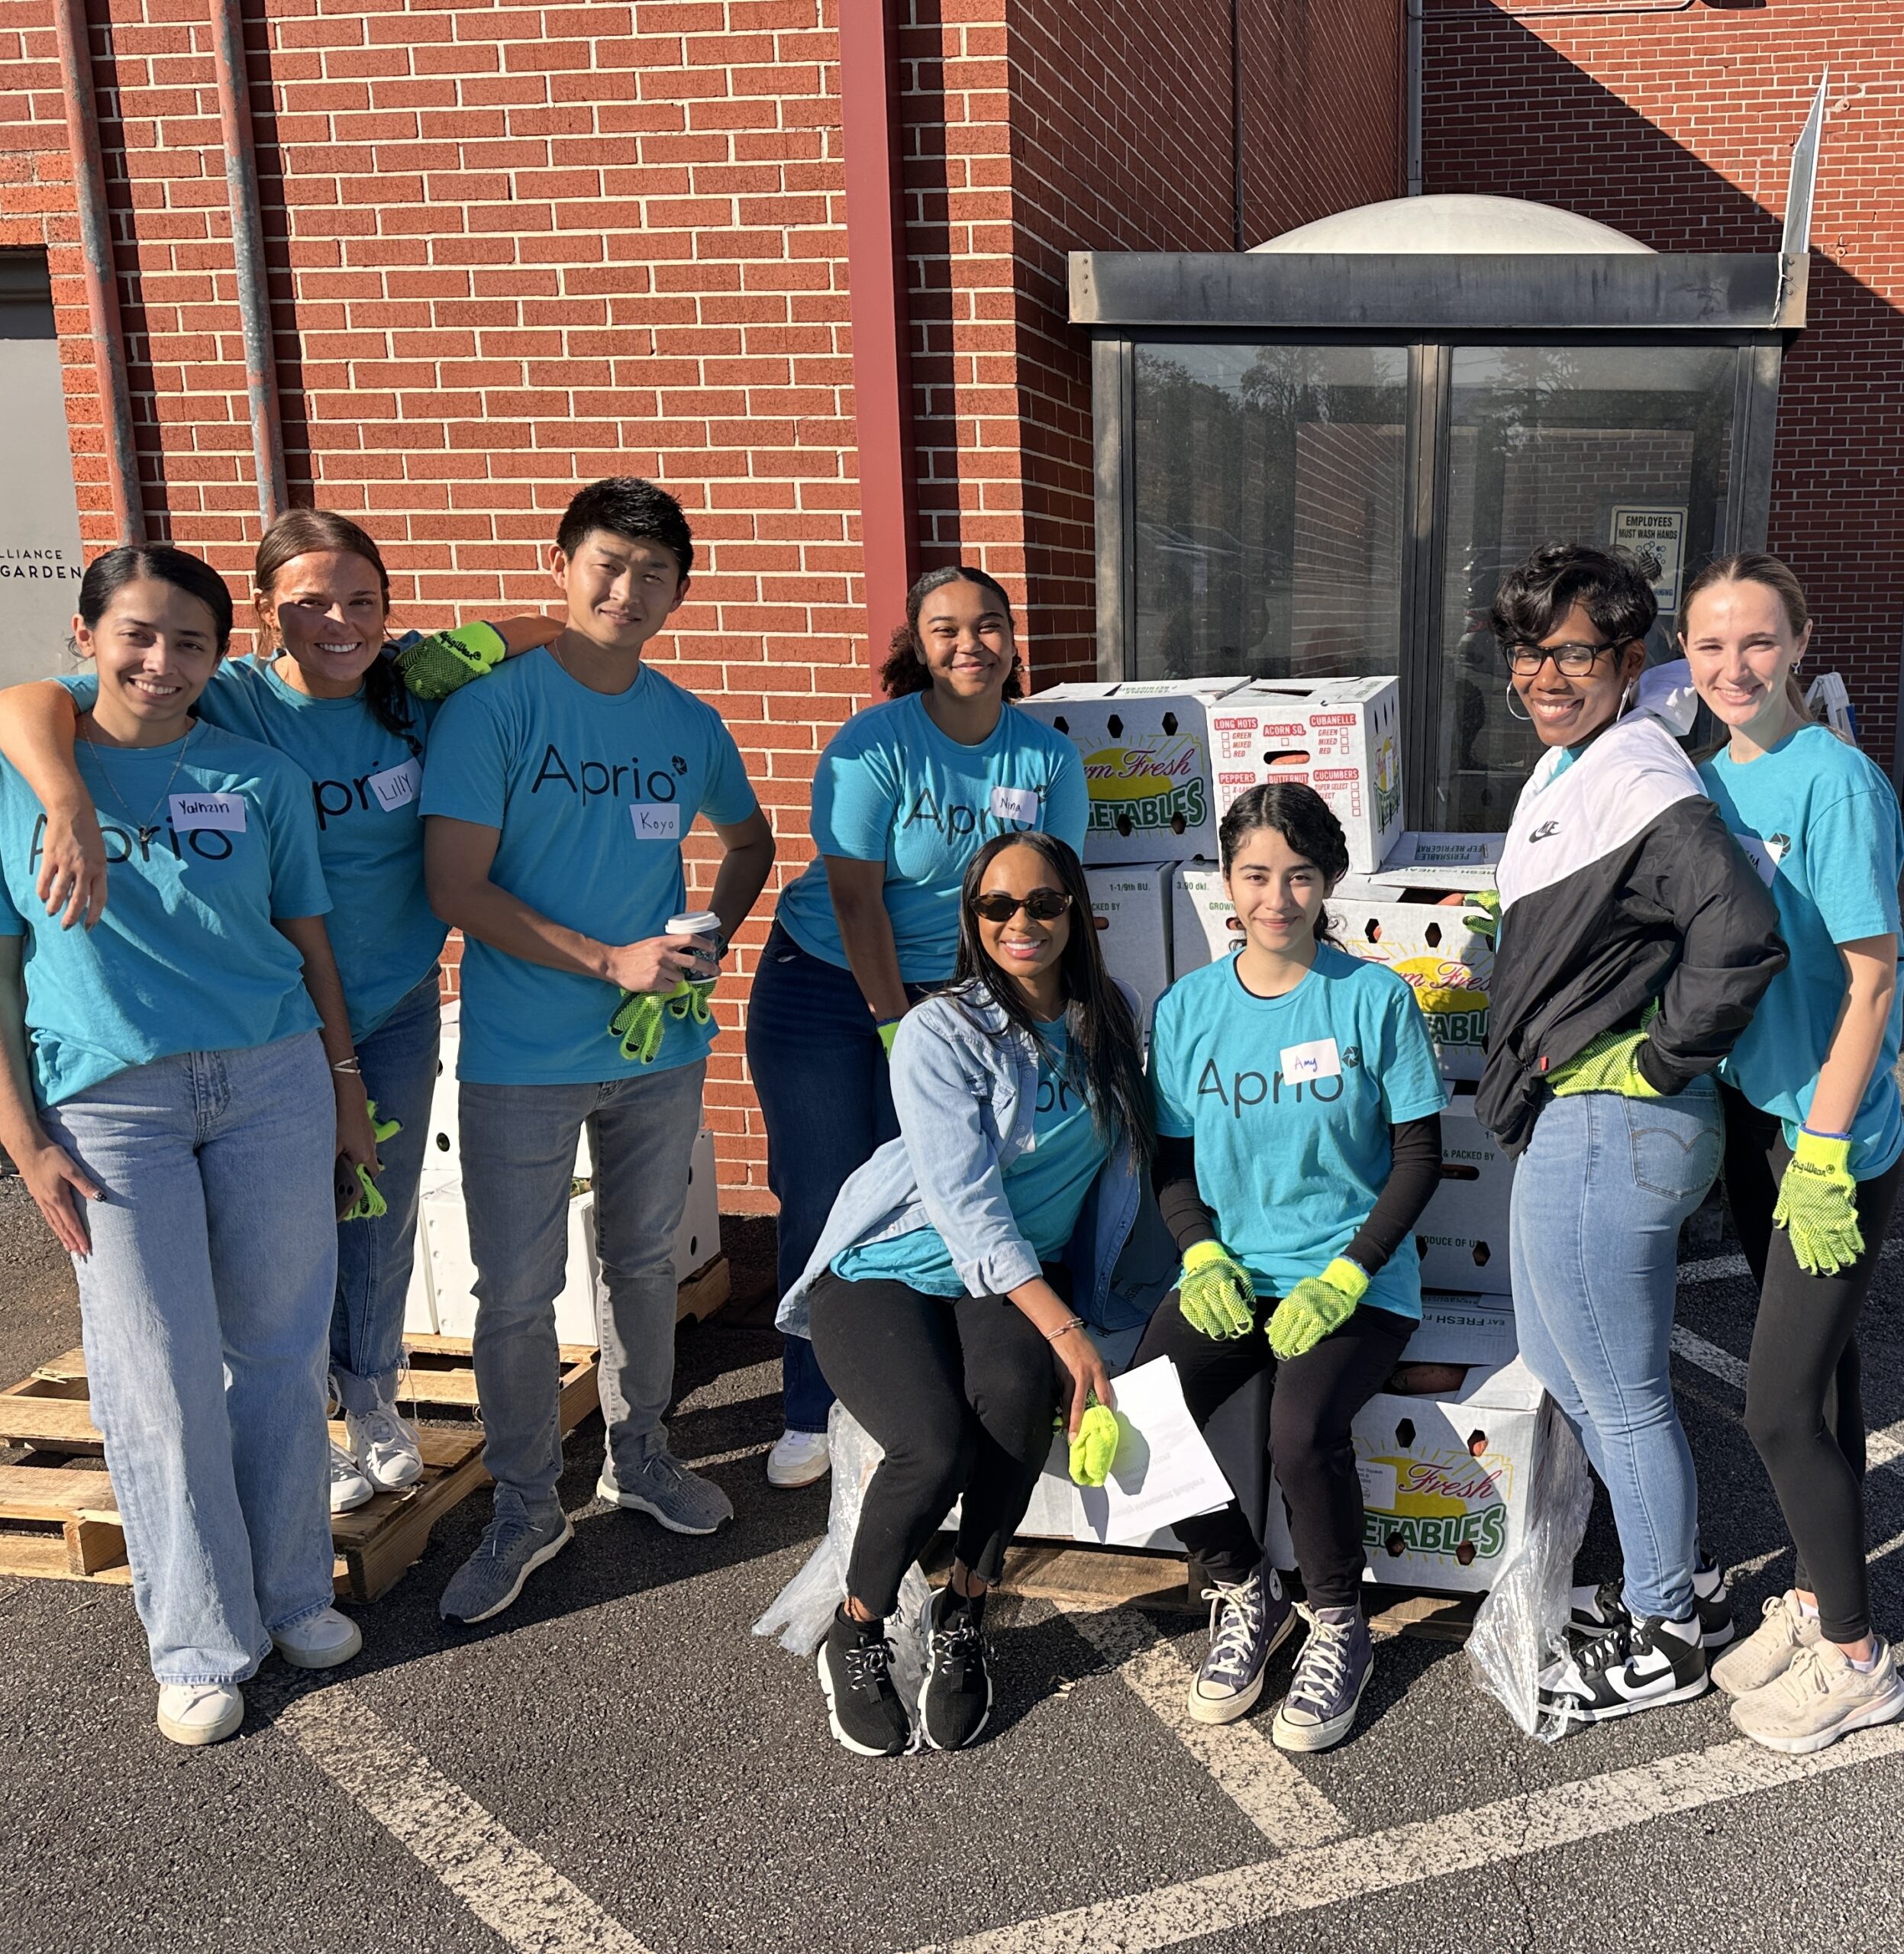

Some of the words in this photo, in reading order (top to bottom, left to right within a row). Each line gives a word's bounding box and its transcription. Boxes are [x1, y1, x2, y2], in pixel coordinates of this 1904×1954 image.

[1625, 515, 1673, 527] EMPLOYEES
[1618, 529, 1636, 539] MUST
[1638, 529, 1655, 540] WASH
[1657, 530, 1678, 540] HANDS
[0, 565, 82, 579] GARDEN
[1215, 718, 1235, 730] LONG
[1237, 717, 1257, 729] HOTS
[1310, 714, 1355, 726] CUBANELLE
[1263, 725, 1290, 735] ACORN
[1292, 724, 1305, 734] SQ.
[1118, 748, 1196, 779] Fresh
[531, 743, 676, 807] Aprio
[1219, 773, 1255, 783] PEPPERS
[1268, 774, 1308, 784] BUTTERNUT
[1315, 769, 1358, 780] CUCUMBERS
[1000, 796, 1021, 813] Nina
[640, 811, 674, 835] Koyo
[1421, 853, 1470, 861] PERISHABLE
[1109, 883, 1135, 892] 1-1/9th
[1176, 882, 1193, 891] 3.90
[1112, 902, 1120, 911] BY
[1295, 1056, 1318, 1072] Amy
[1443, 1149, 1449, 1158] &
[1451, 1150, 1482, 1160] PACKED
[1484, 1152, 1496, 1161] BY
[1455, 1238, 1467, 1247] OF
[1436, 1315, 1485, 1326] FRESH
[1399, 1462, 1502, 1499] Fresh
